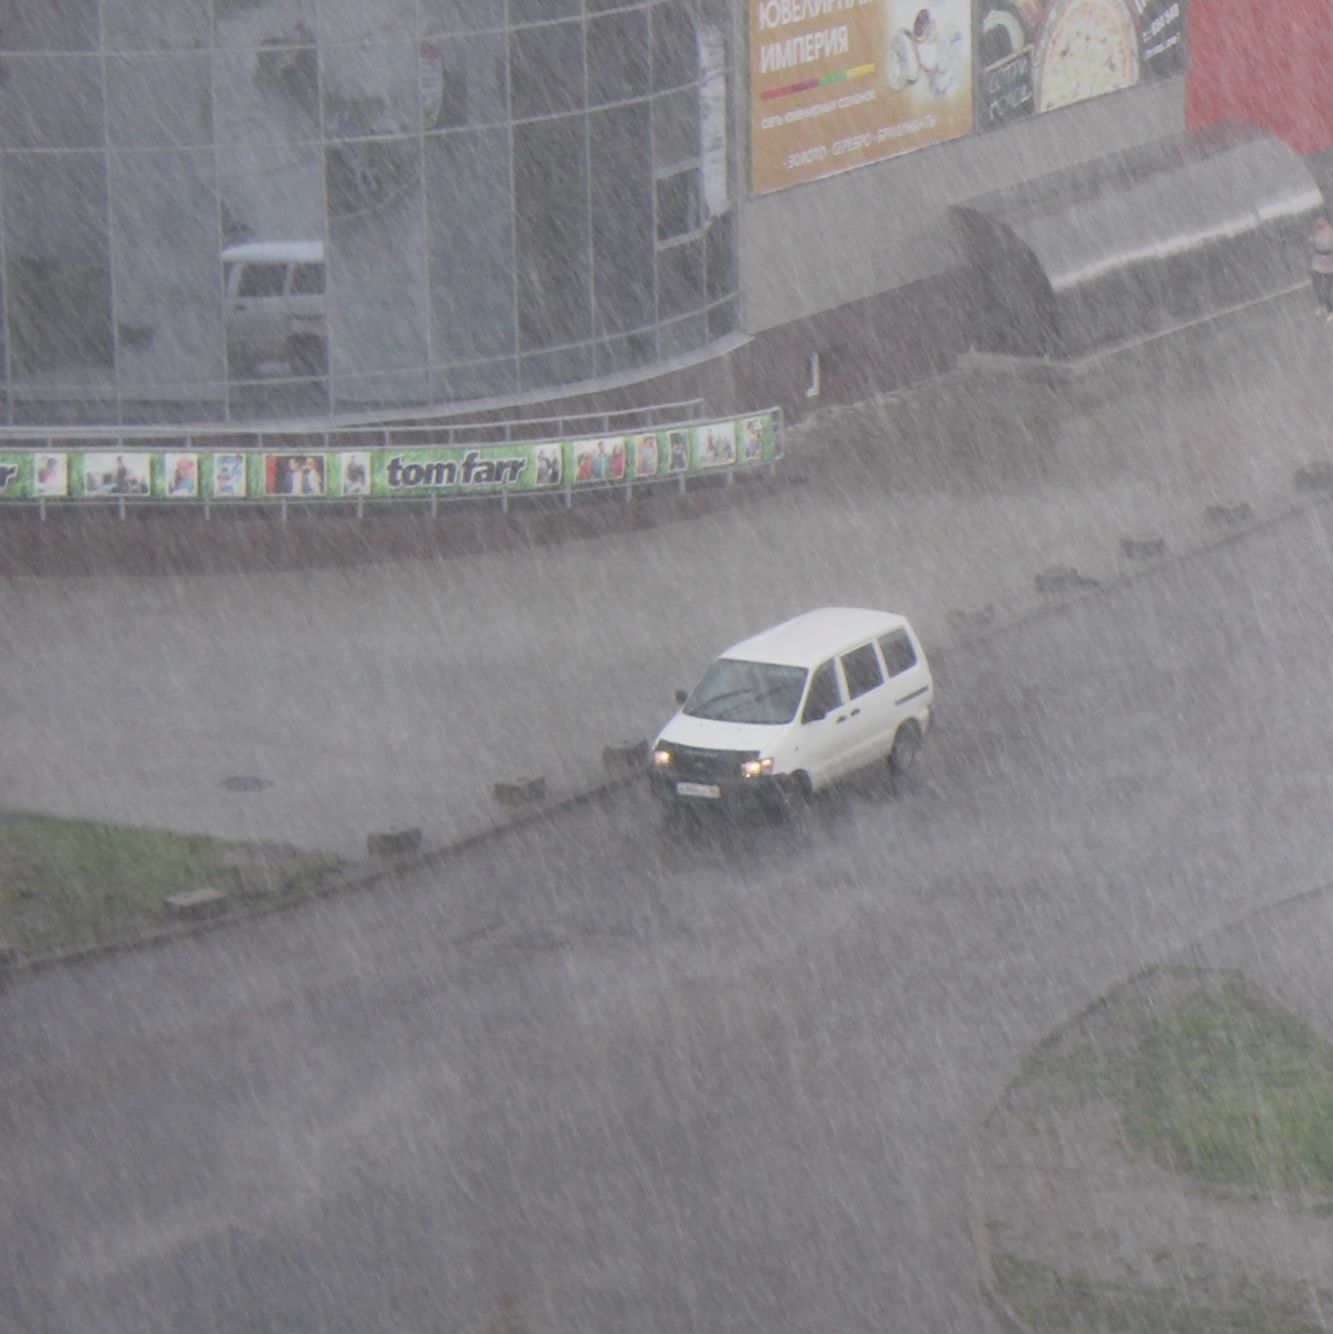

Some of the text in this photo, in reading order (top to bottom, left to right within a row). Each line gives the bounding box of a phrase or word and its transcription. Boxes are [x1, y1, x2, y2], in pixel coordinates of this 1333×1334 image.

[759, 0, 874, 30] ЮВЕЛИ
[760, 25, 849, 74] ИМПЕРИЯ
[387, 457, 458, 487] tom
